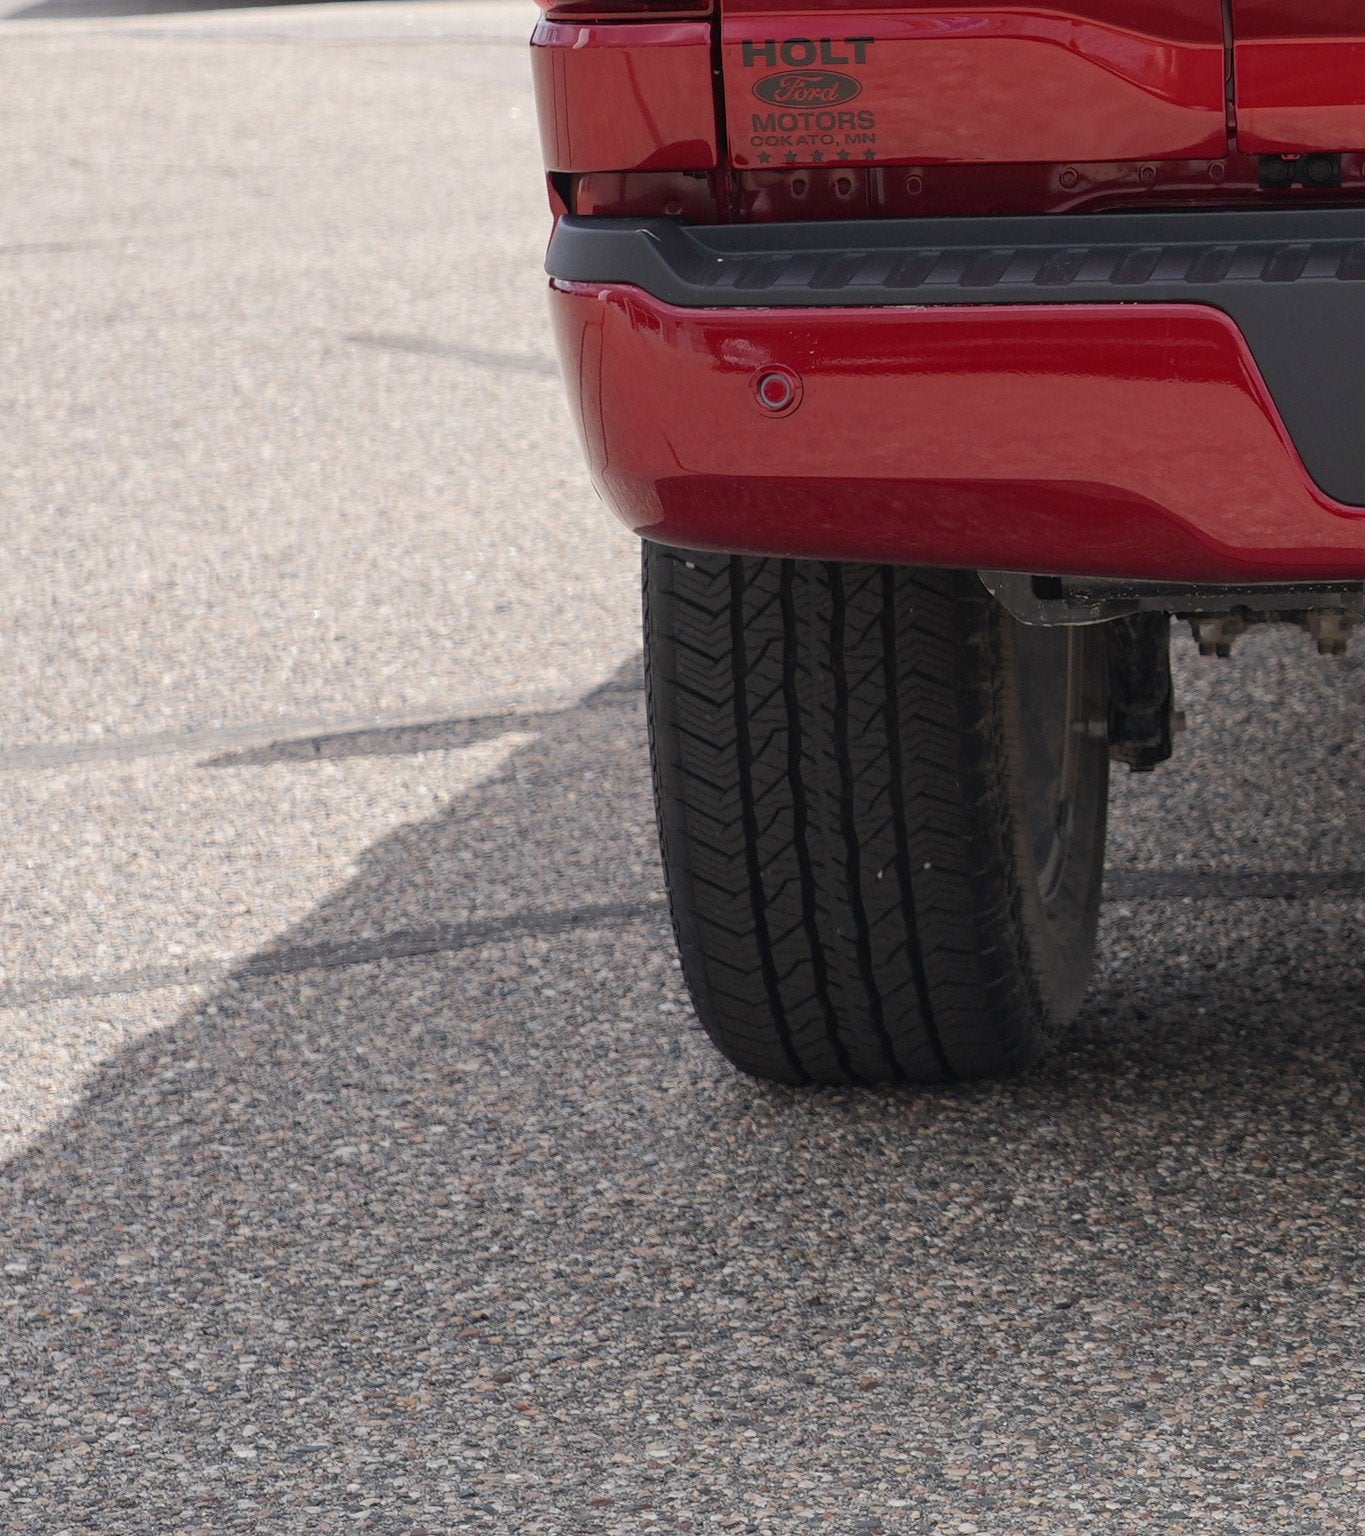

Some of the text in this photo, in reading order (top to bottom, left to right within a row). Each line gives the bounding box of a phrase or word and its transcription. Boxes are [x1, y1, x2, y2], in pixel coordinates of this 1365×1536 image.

[741, 37, 876, 67] HOLT
[774, 75, 841, 102] Ford
[752, 110, 876, 133] MOTORS
[750, 133, 876, 147] COKATO, MN
